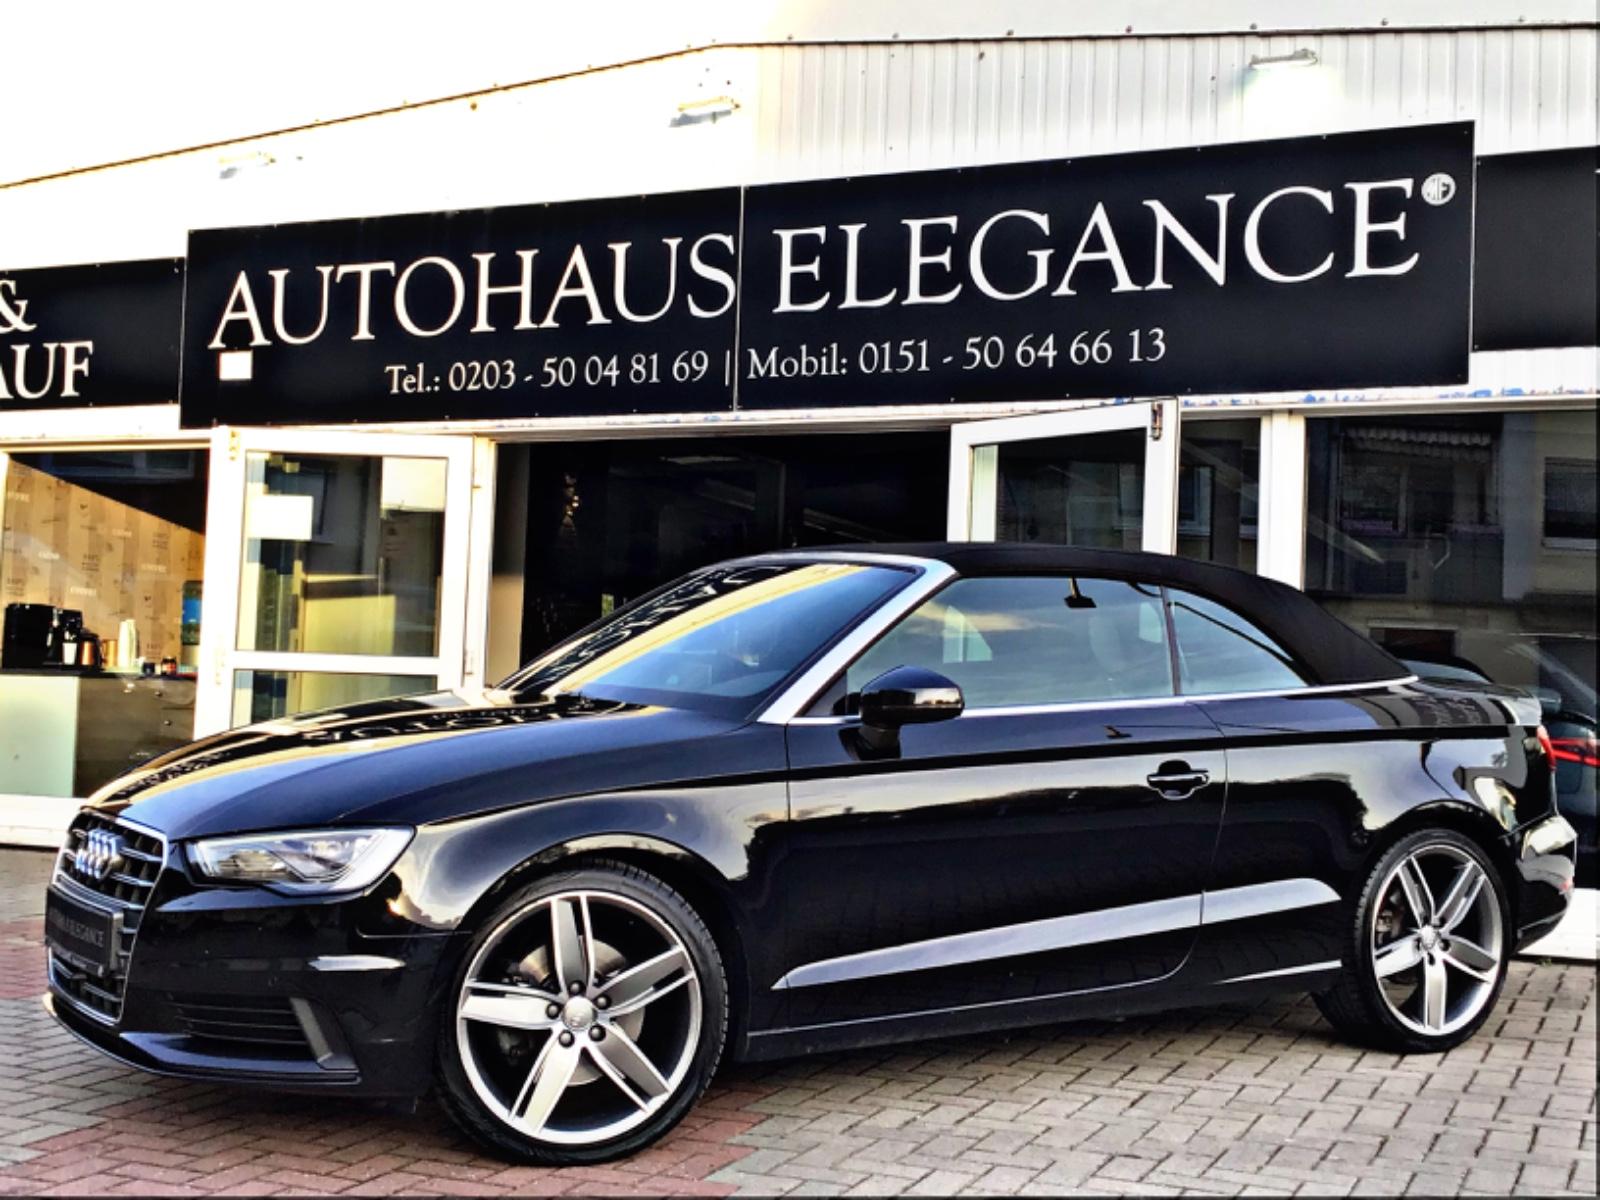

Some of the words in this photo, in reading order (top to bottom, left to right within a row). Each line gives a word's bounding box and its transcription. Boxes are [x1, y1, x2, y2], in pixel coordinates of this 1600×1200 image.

[207, 232, 736, 350] AUTOHAUS
[772, 177, 1420, 314] ELEGANCE
[385, 362, 441, 397] Tel.:
[448, 358, 516, 392] 0203
[540, 355, 577, 389] 50
[584, 353, 621, 388] 04
[629, 352, 660, 384] 81
[672, 349, 709, 382] 69
[747, 342, 849, 379] Mobil:
[858, 338, 930, 374] 0151
[962, 335, 1004, 370] 50
[1015, 333, 1058, 369] 64
[1069, 329, 1113, 366] 66
[1129, 326, 1166, 363] 13
